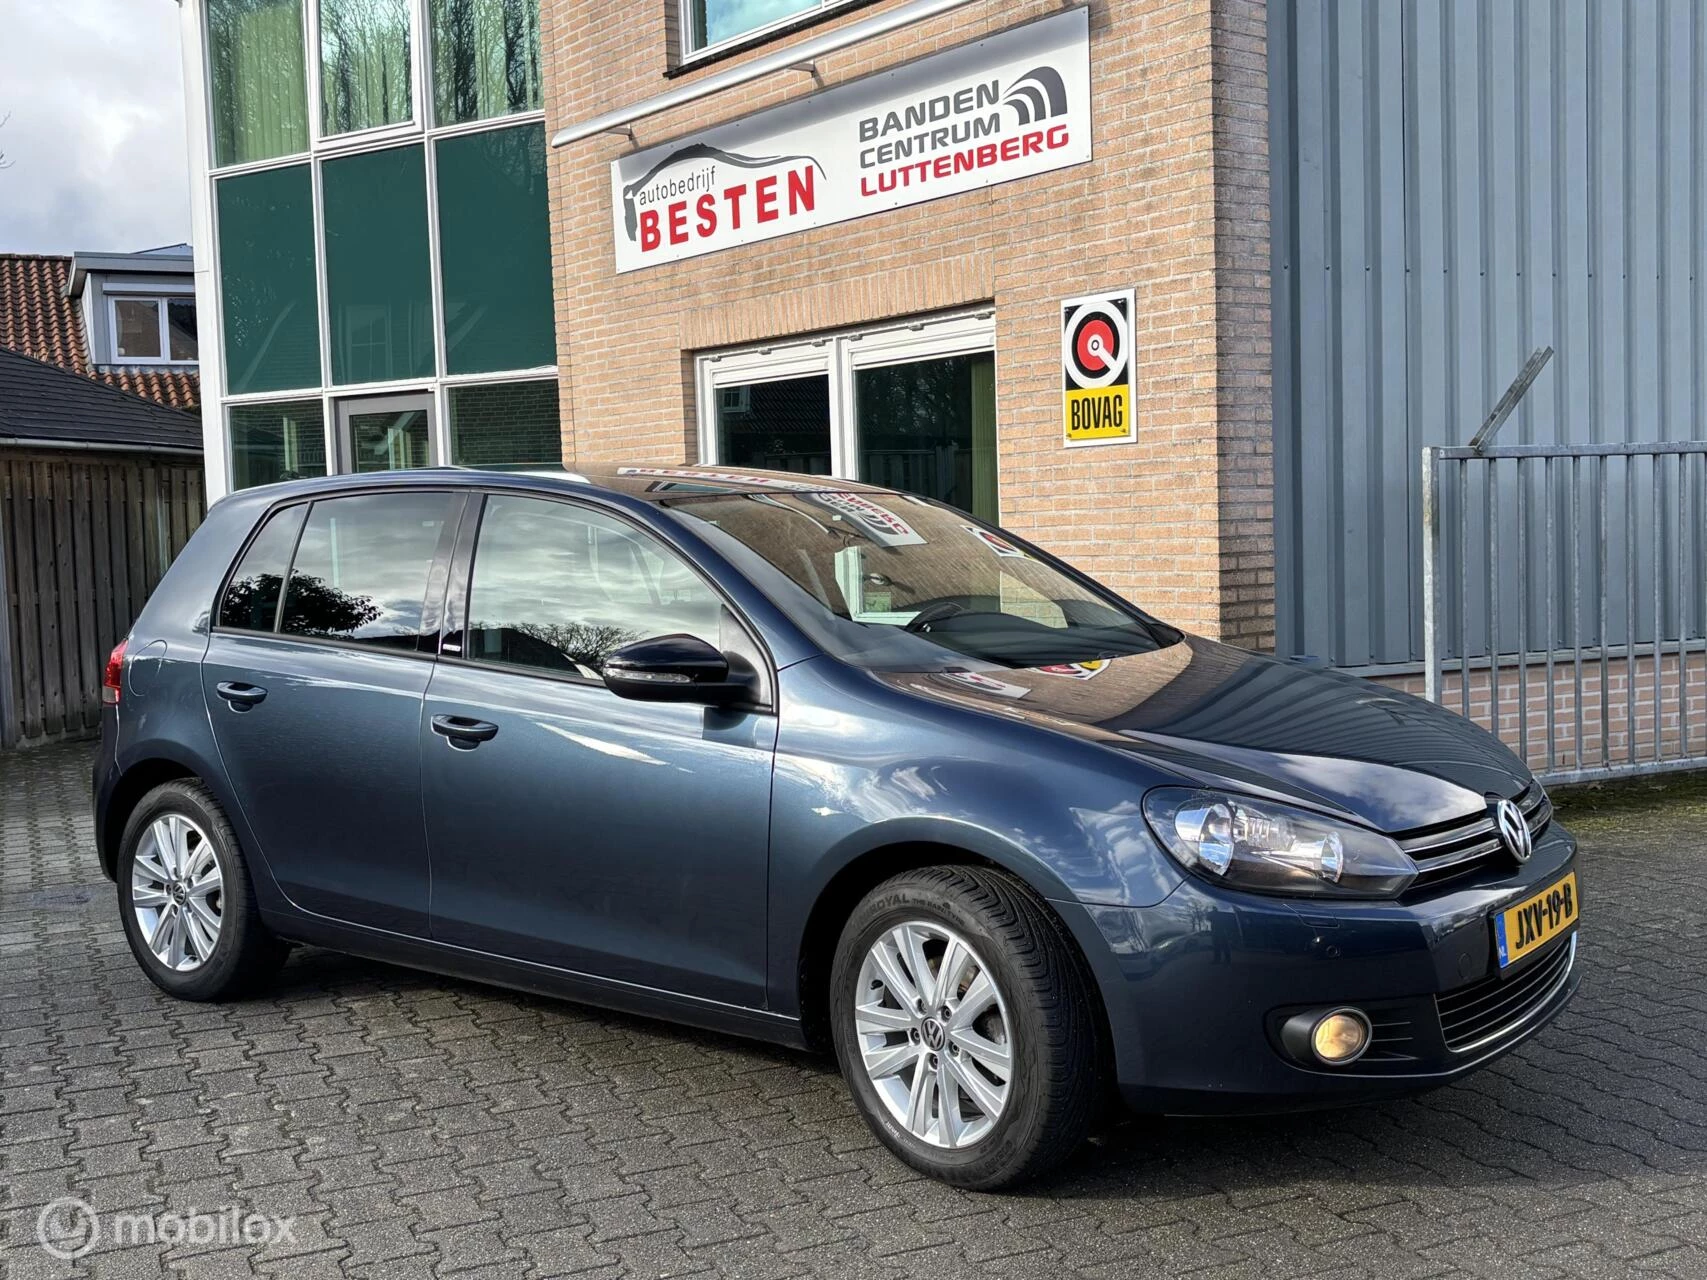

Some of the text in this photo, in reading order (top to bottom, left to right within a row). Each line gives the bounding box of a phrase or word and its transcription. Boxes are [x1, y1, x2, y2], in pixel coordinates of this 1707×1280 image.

[858, 79, 1000, 143] BANDEN
[858, 112, 1001, 170] CENTRUM
[638, 165, 717, 206] autobedrijf
[860, 124, 1070, 198] LUTTENBERG
[640, 165, 816, 253] BESTEN
[1070, 394, 1123, 431] BOVAG
[1515, 882, 1573, 949] JXV-19-B
